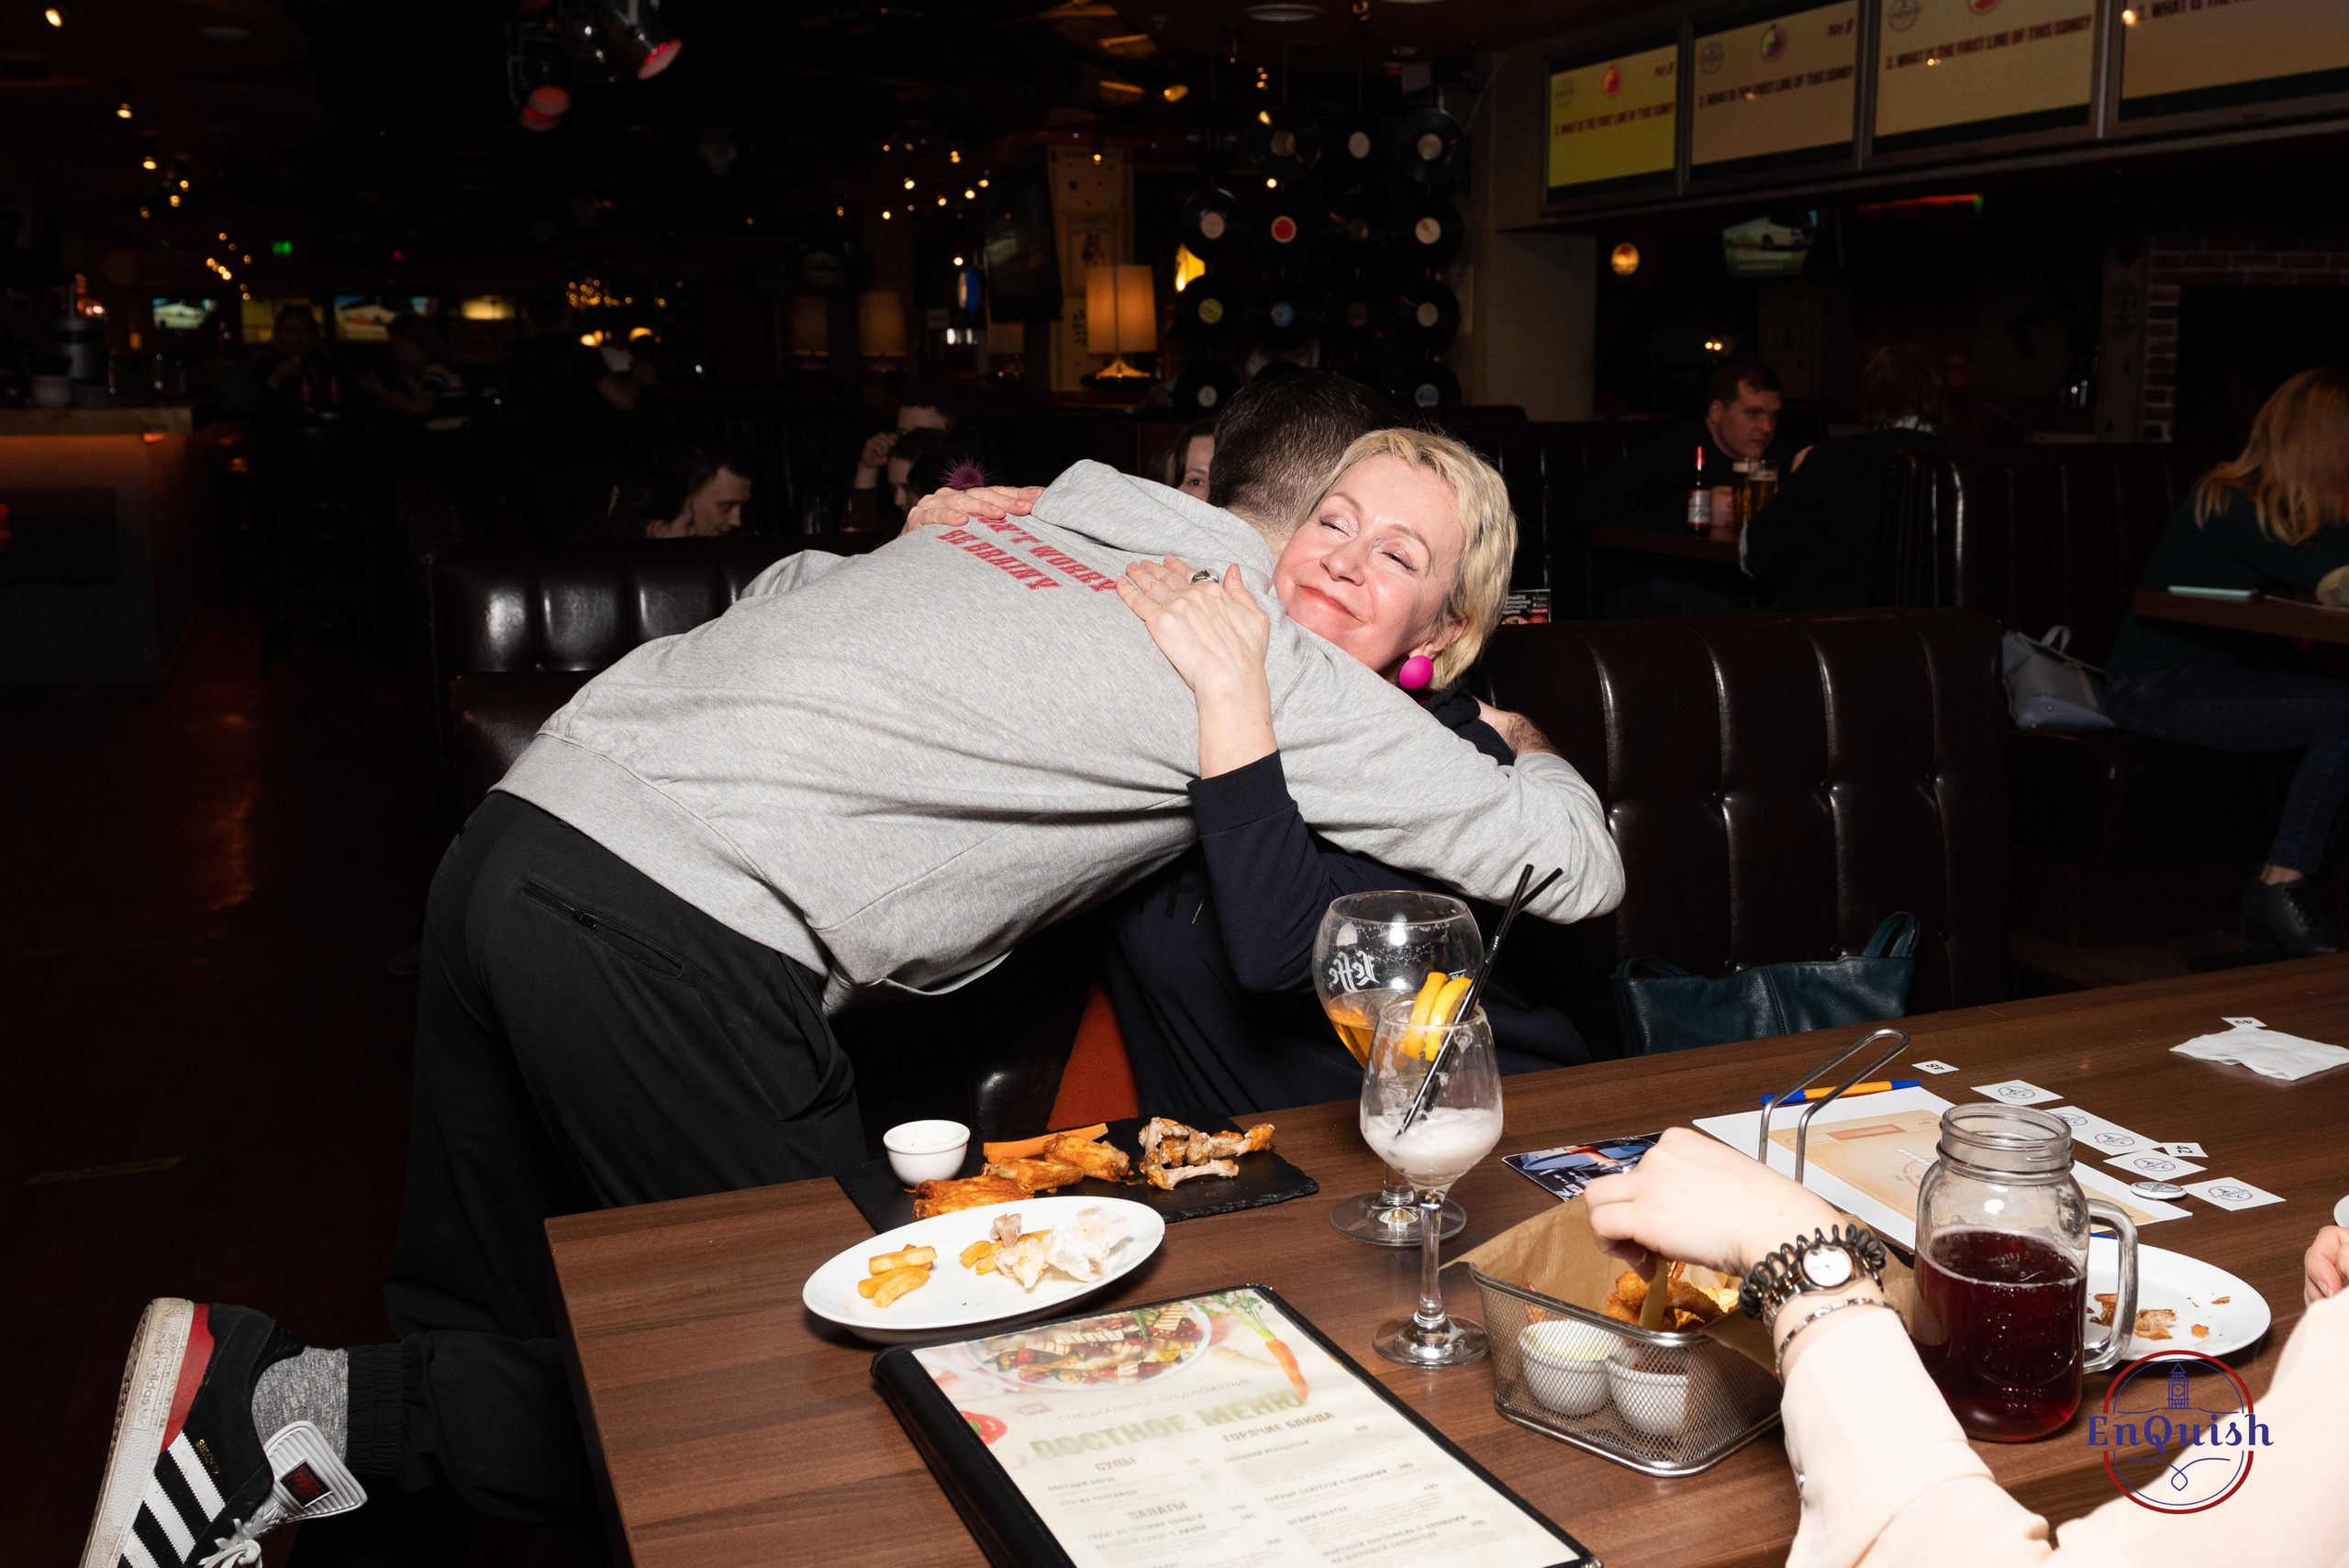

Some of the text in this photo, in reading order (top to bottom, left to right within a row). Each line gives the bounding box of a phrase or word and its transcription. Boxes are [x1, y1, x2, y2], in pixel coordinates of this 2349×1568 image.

[1958, 35, 1985, 53] FIRST
[1987, 29, 2009, 48] LINE
[2014, 27, 2024, 42] OF
[2029, 21, 2052, 39] THIS
[935, 529, 1063, 591] BE BRAINY
[1028, 545, 1117, 592] WORRY
[2176, 1145, 2194, 1153] 42
[1156, 1378, 1253, 1401] ПРЕДЛОЖЕНИЕ
[1029, 1413, 1196, 1460] ПОСТНОЕ
[1193, 1389, 1311, 1425] МЕНЮ
[1221, 1411, 1337, 1441] ГОРЯЧИЕ БЛЮДА
[1094, 1456, 1137, 1471] СУПЫ
[1128, 1500, 1188, 1518] САЛАТЫ
[1319, 1506, 1350, 1516] БУРГЕР
